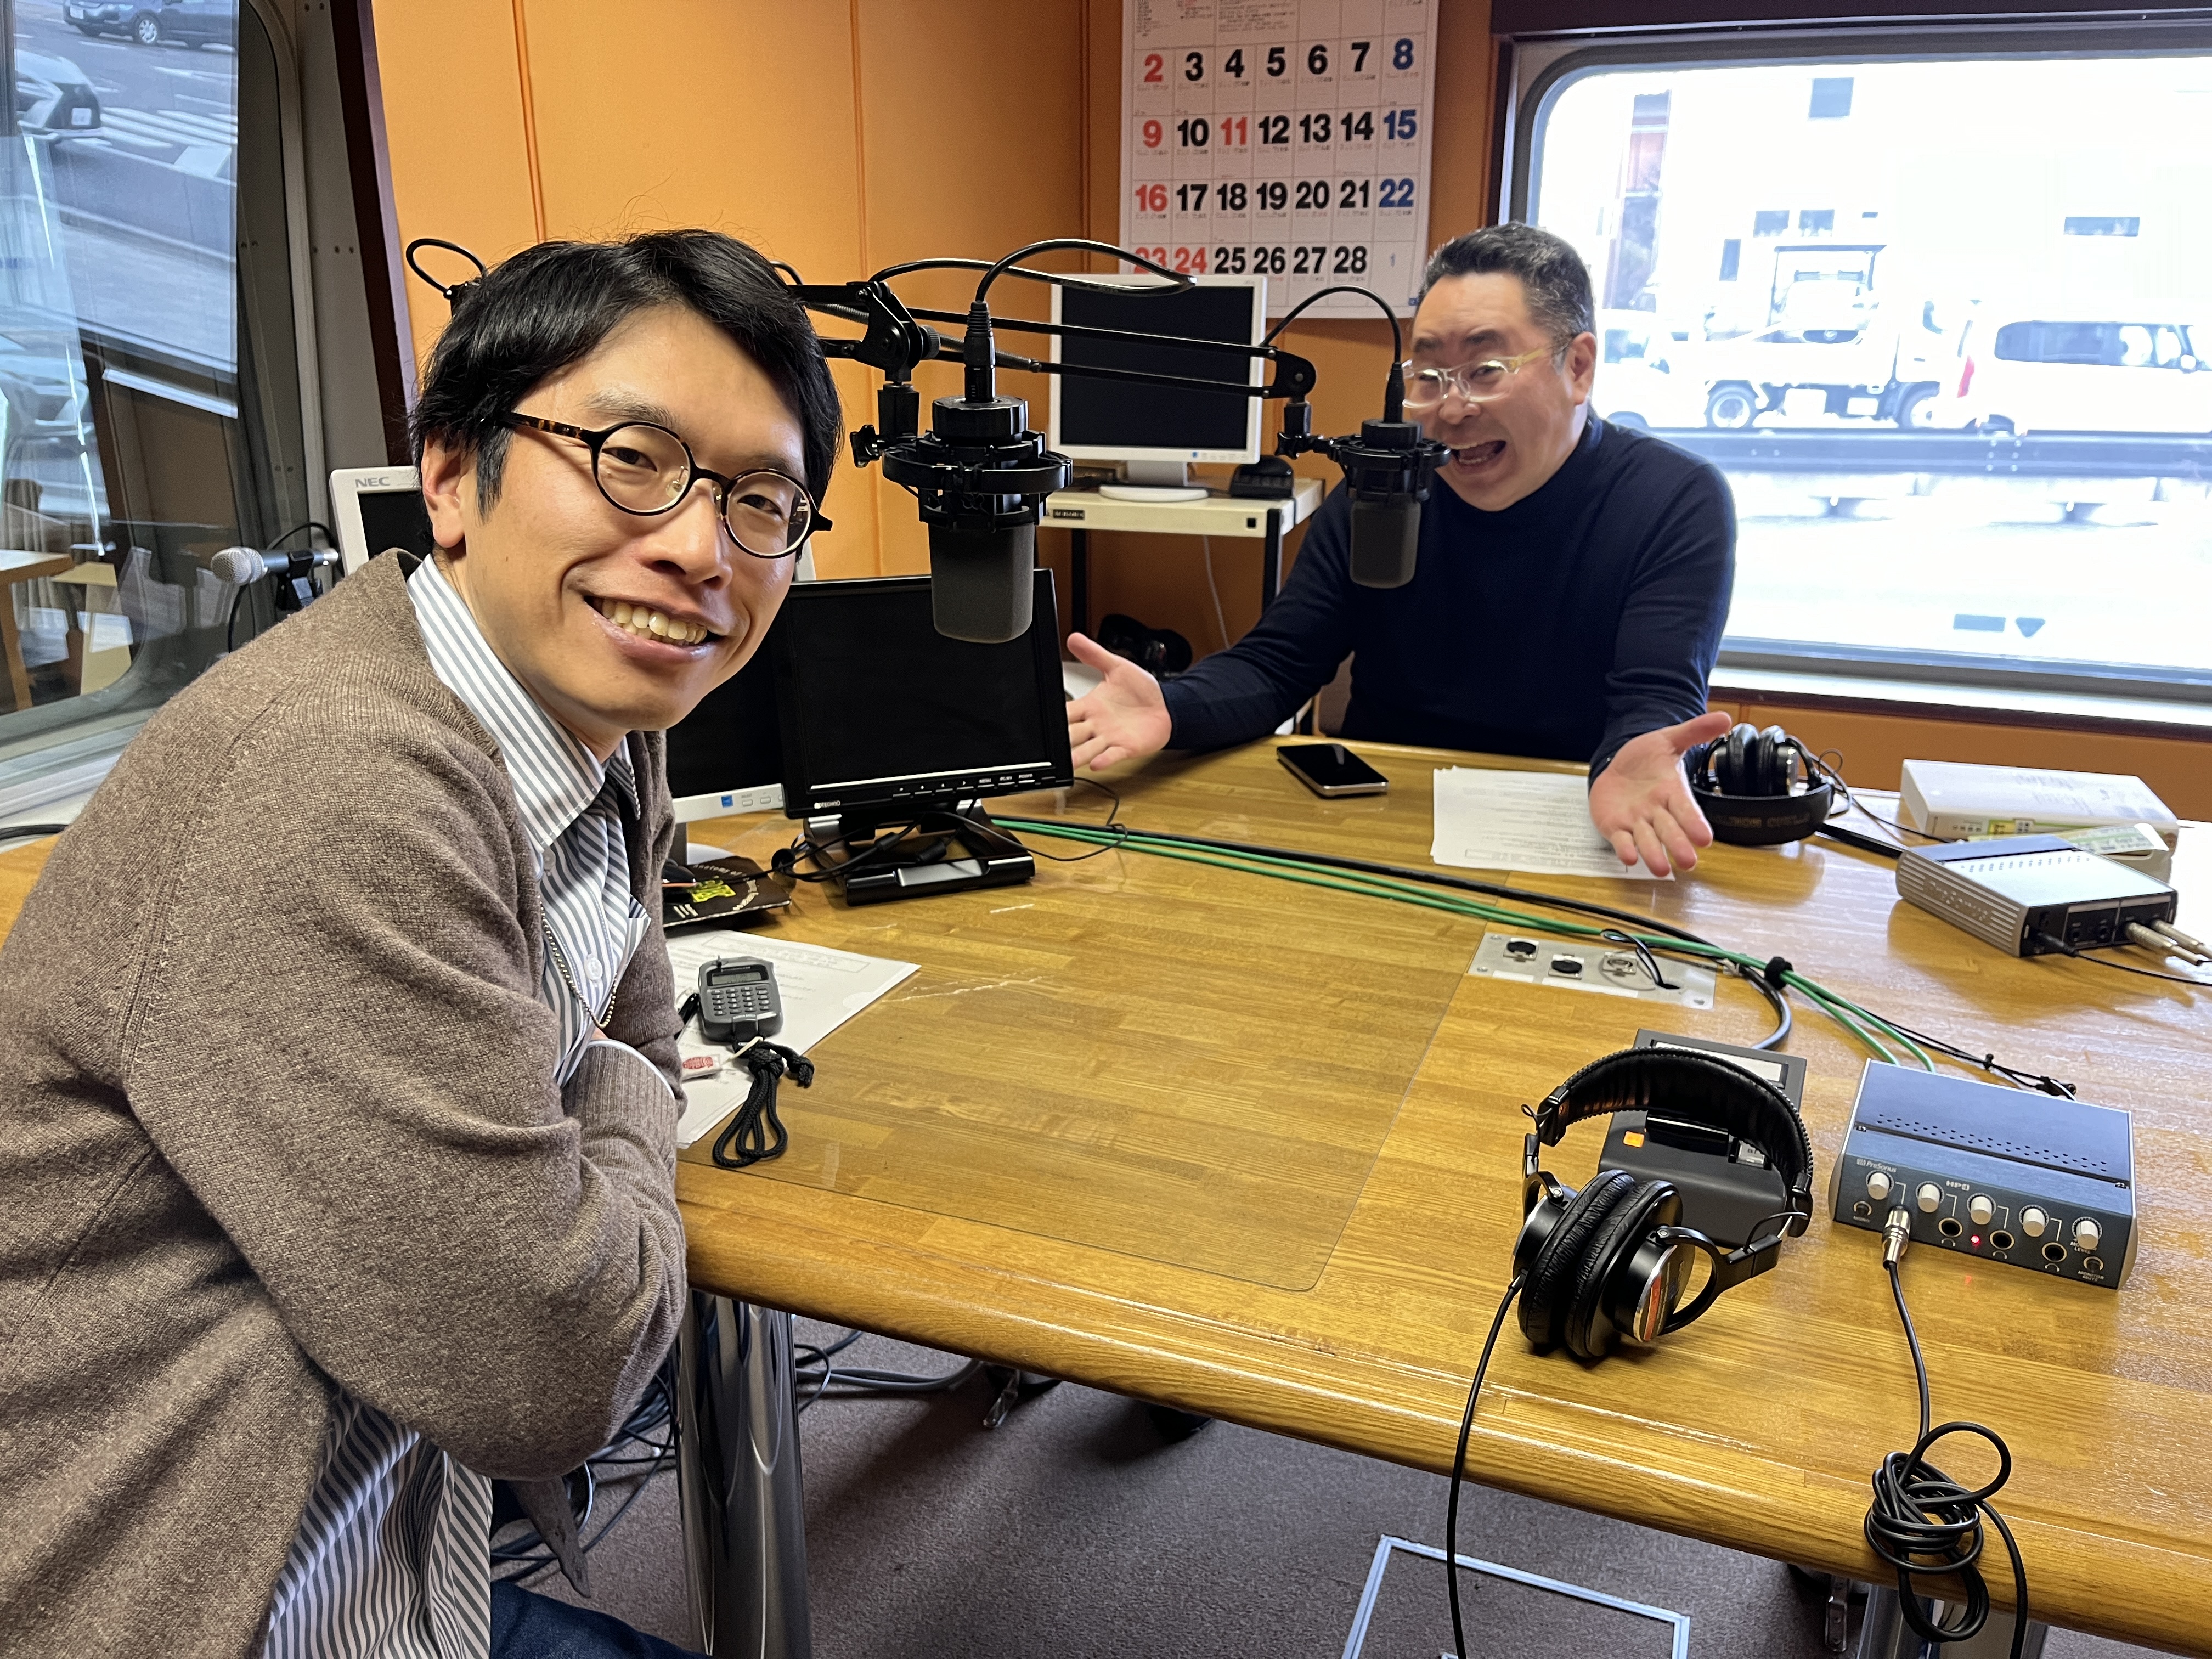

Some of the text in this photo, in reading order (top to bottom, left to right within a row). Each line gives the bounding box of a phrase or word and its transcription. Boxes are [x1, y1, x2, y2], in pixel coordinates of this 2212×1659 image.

[1143, 38, 1414, 83] 2 3 4 5 6 7 8
[1143, 109, 1417, 148] 9 10 11 12 13 14 15
[1135, 178, 1414, 212] 16 17 18 19 20 21 22
[1133, 247, 1167, 274] 23
[1175, 247, 1207, 274] 24
[1214, 247, 1246, 274] 25
[1253, 246, 1286, 274] 26
[1293, 246, 1327, 274] 27
[1333, 246, 1367, 274] 28
[355, 477, 391, 488] NEC
[1866, 1159, 1897, 1173] PreSonus
